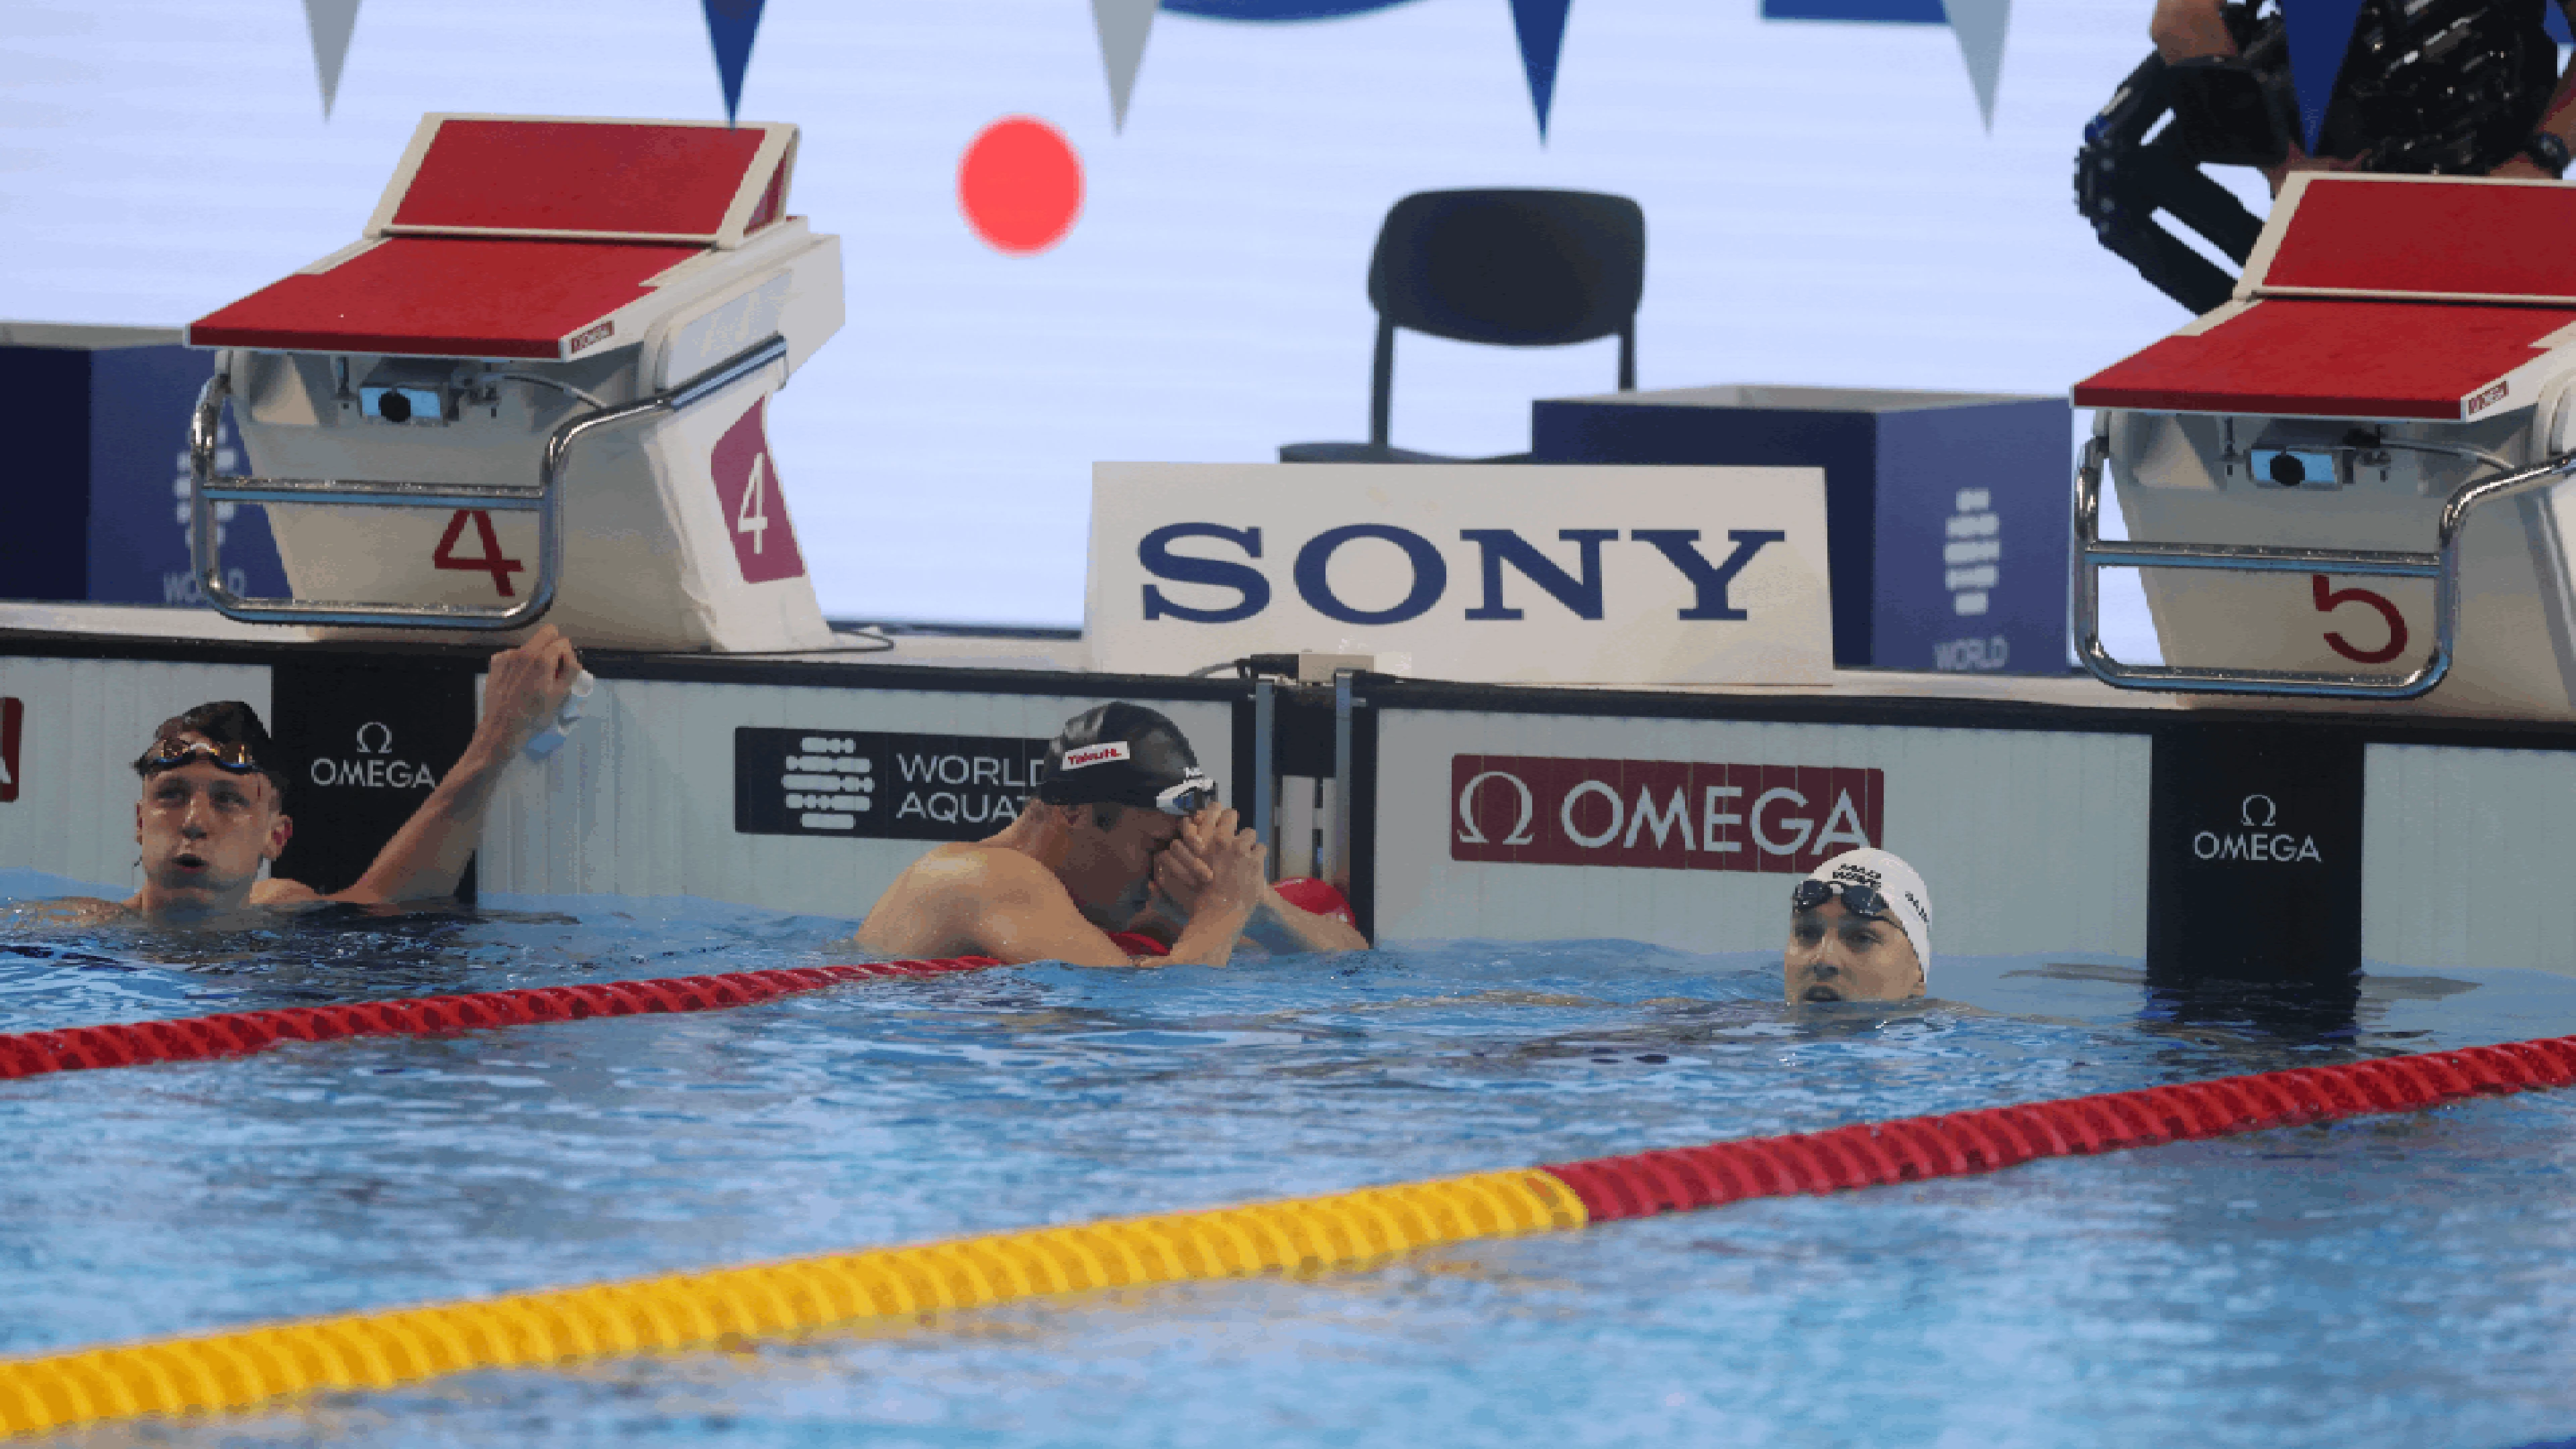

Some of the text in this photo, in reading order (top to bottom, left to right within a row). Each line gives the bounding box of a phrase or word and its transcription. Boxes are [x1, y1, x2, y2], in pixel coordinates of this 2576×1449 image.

[739, 452, 767, 554] 4
[433, 509, 524, 596] 4
[1137, 521, 1785, 625] SONY
[1934, 635, 2010, 671] WORLD
[2312, 574, 2408, 663] 5
[311, 757, 435, 788] OMEGA
[896, 791, 1030, 824] AQUA
[1561, 780, 1871, 855] OMEGA
[2194, 830, 2322, 863] OMEGA
